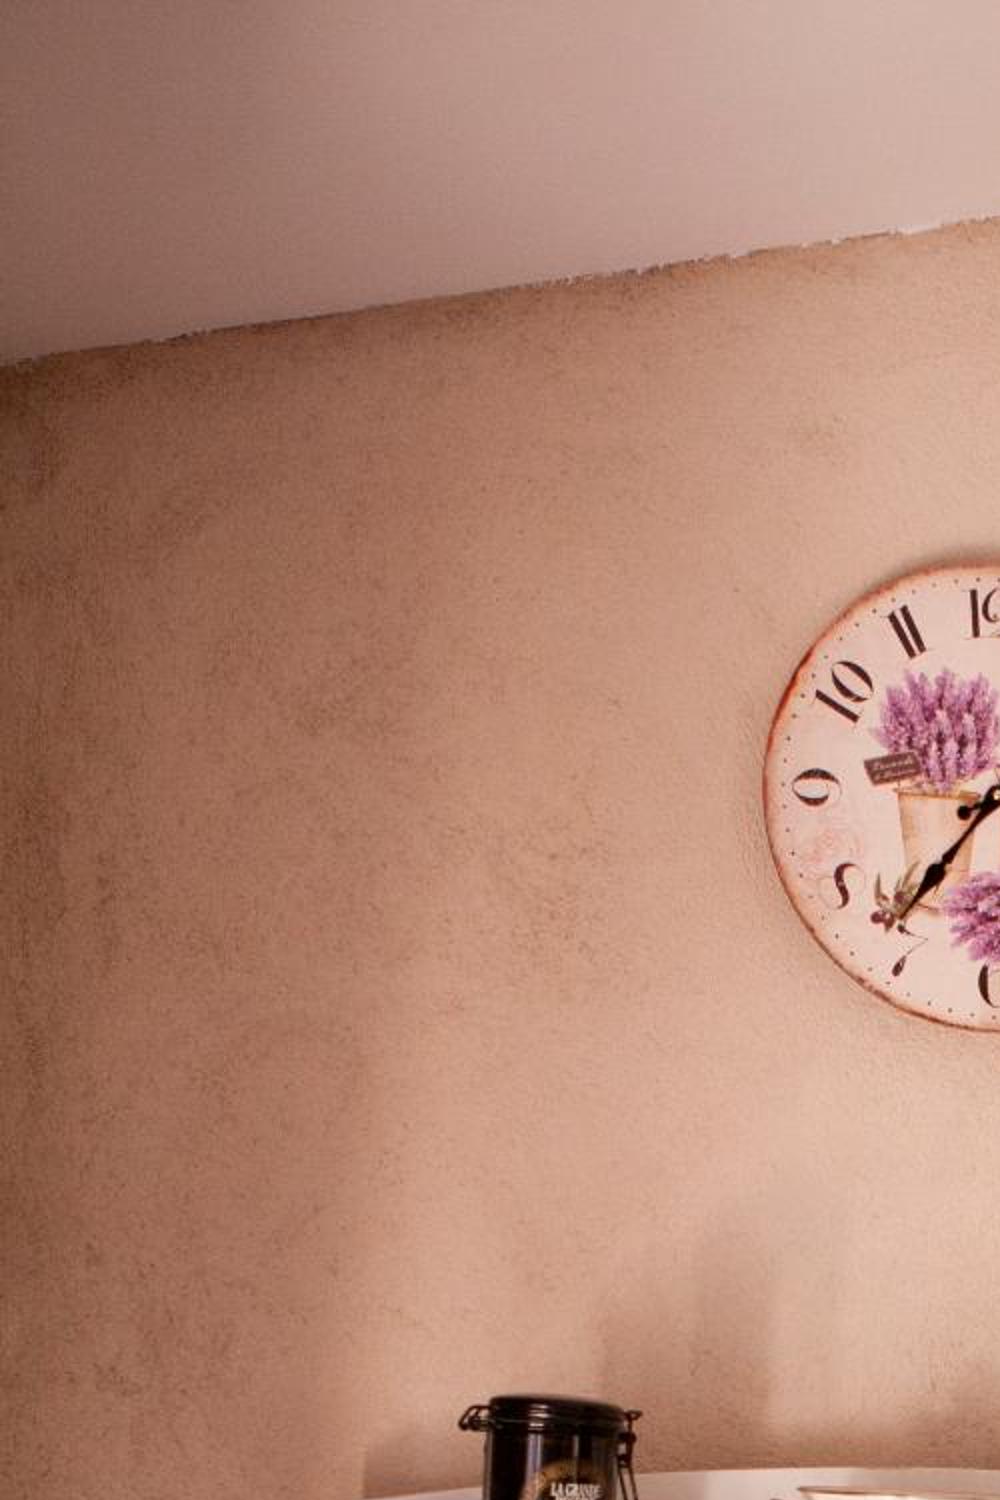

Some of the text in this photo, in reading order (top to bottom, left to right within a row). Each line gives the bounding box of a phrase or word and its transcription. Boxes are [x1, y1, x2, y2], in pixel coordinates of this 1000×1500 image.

[884, 603, 932, 661] 11
[813, 660, 875, 724] 10
[791, 768, 842, 807] 9
